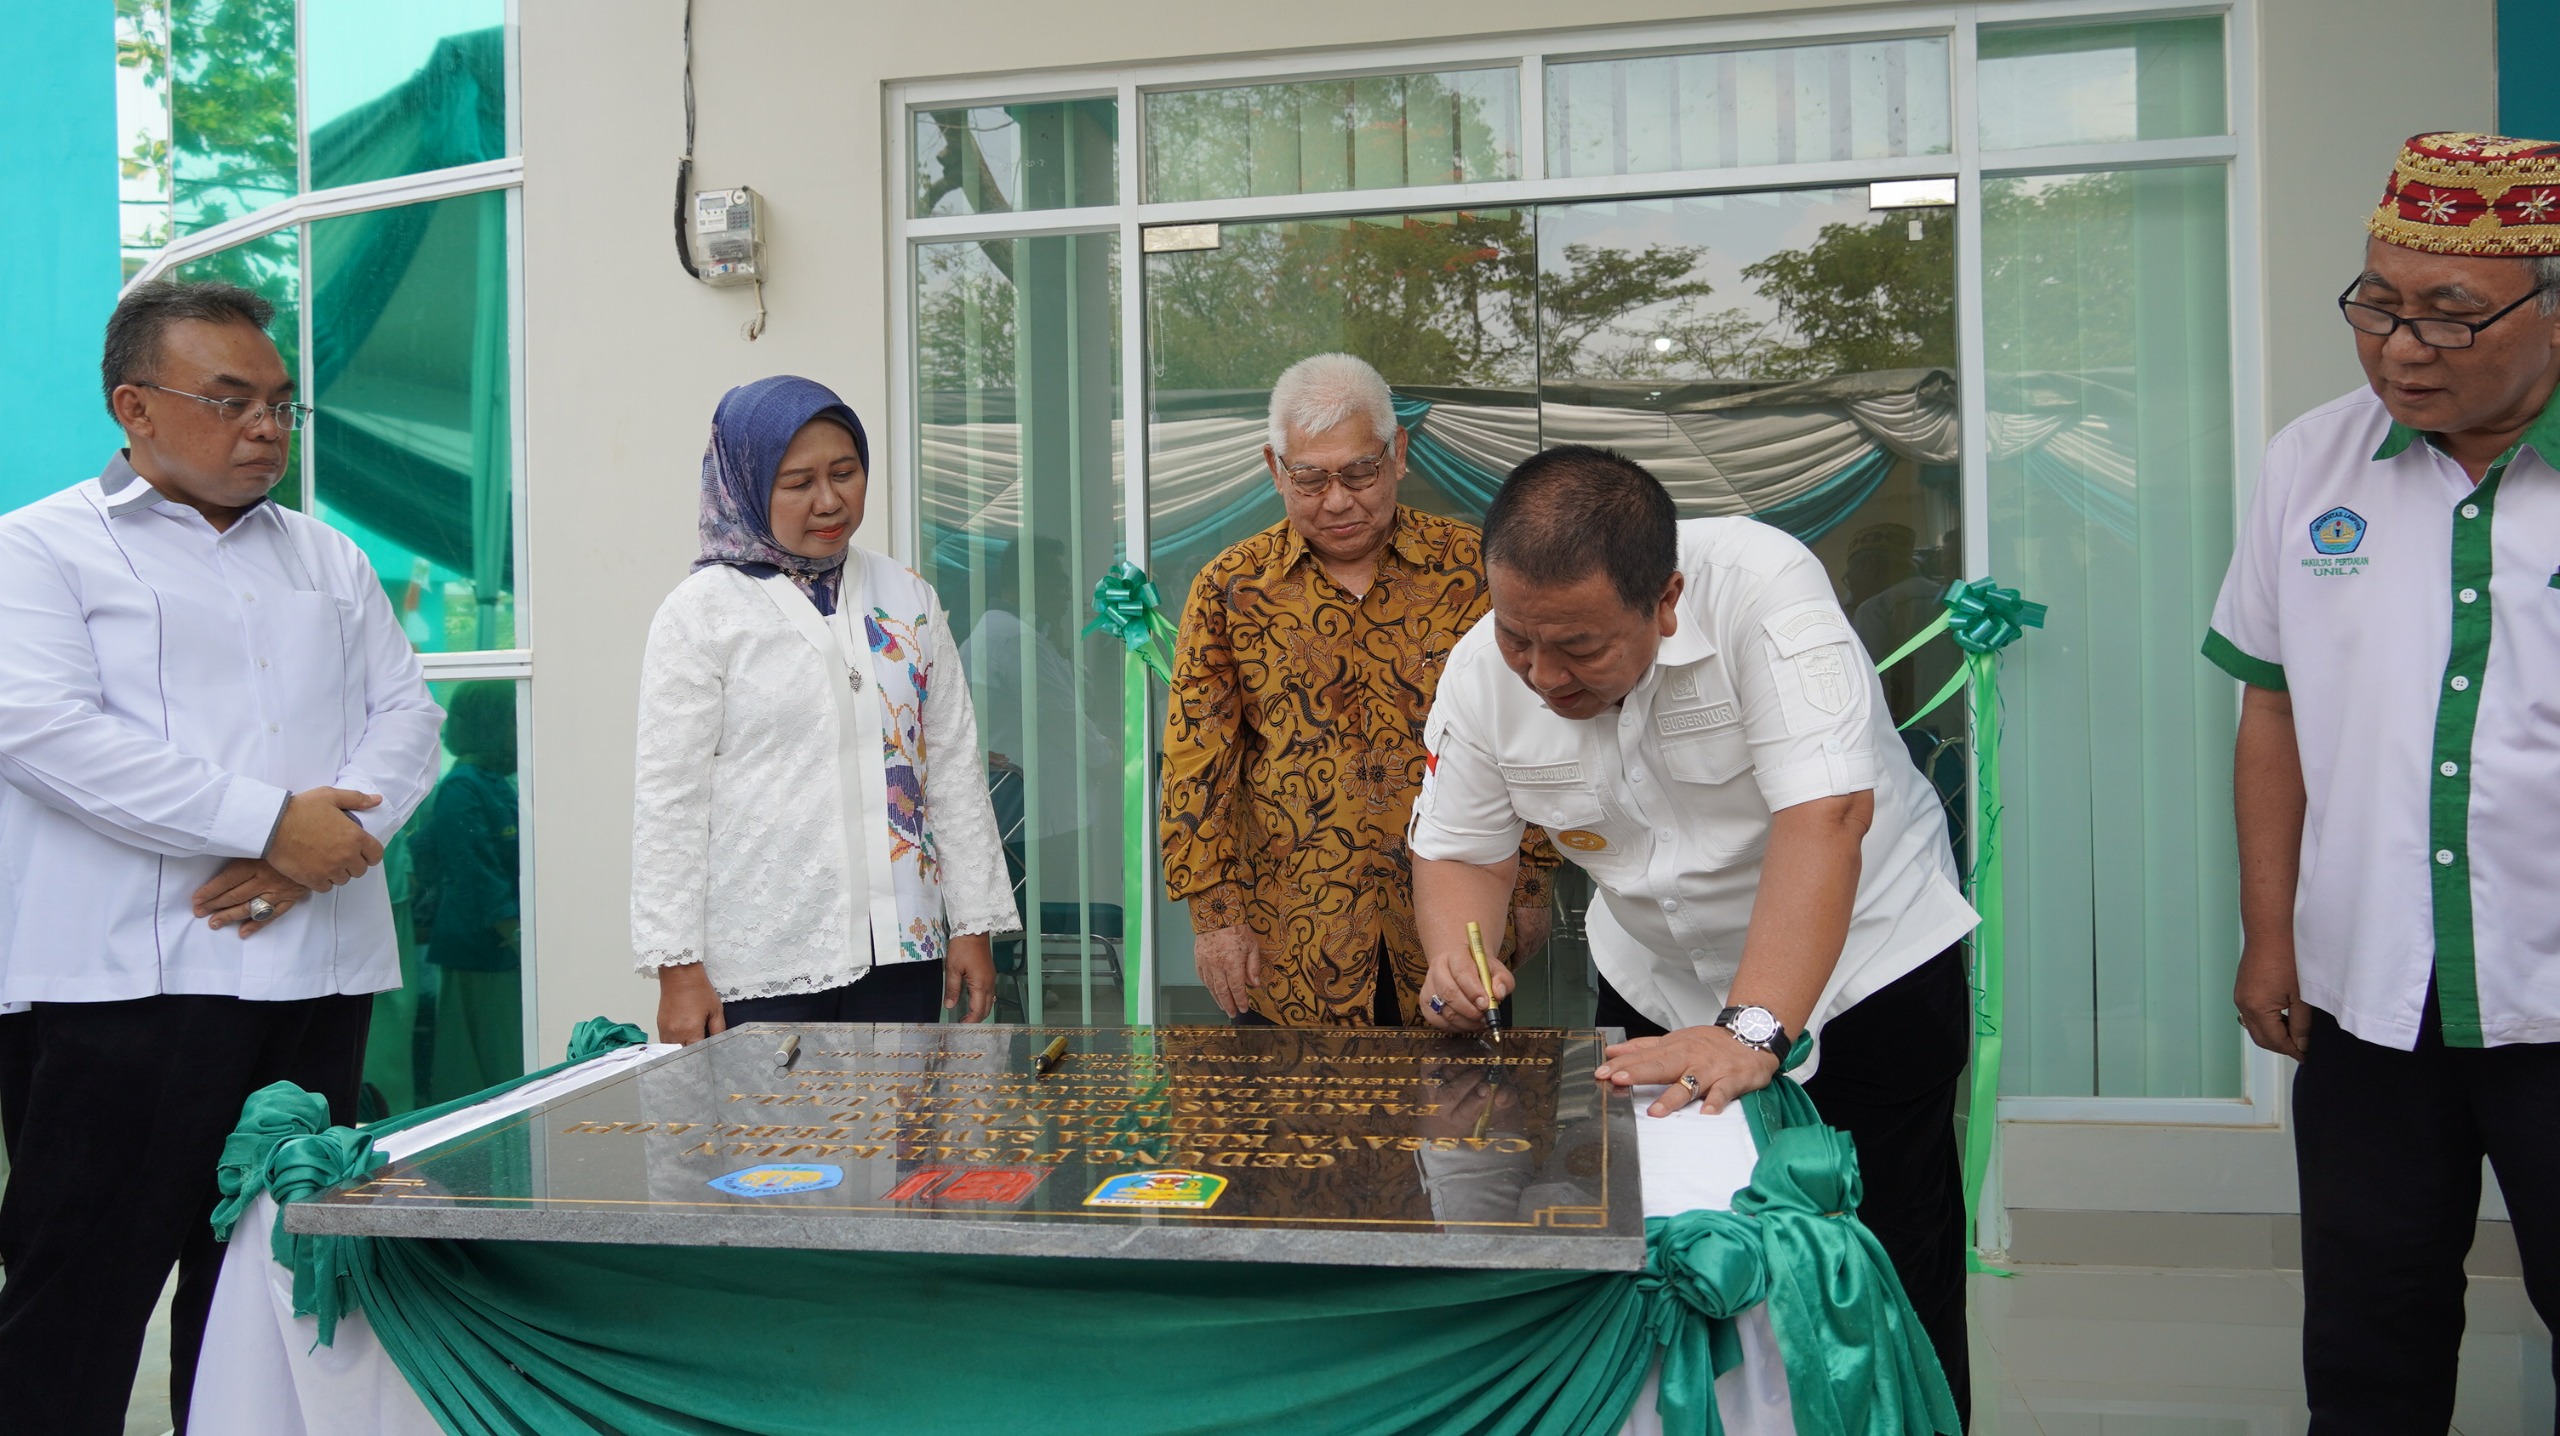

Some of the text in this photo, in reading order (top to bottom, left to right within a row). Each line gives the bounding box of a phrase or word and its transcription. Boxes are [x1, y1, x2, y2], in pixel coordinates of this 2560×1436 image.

[2301, 557, 2369, 567] FAKULTAS PERTANIAN
[2313, 567, 2360, 577] UNILA
[1662, 705, 1733, 731] GUBERNUR
[814, 1050, 986, 1061] REKTOR UNILA
[1186, 1054, 1275, 1063] SUNGAI
[1303, 1055, 1553, 1066] GUBERNUR LAMPUNG
[1174, 1075, 1246, 1083] PADA
[1247, 1076, 1442, 1086] DIRESMIKAN
[948, 1084, 1153, 1096] KELUARGA
[1156, 1087, 1261, 1099] DARI
[1263, 1088, 1401, 1100] HIBAH
[726, 1095, 1443, 1116] FAKULTAS PERTANIAN UNILA
[828, 1111, 1277, 1131] LADA DAN KAKAO
[561, 1121, 1532, 1153] CASSAVA, KELAPA SAWIT, TEBU, KOPI
[678, 1142, 1335, 1169] GEDUNG PUSAT KAJIAN
